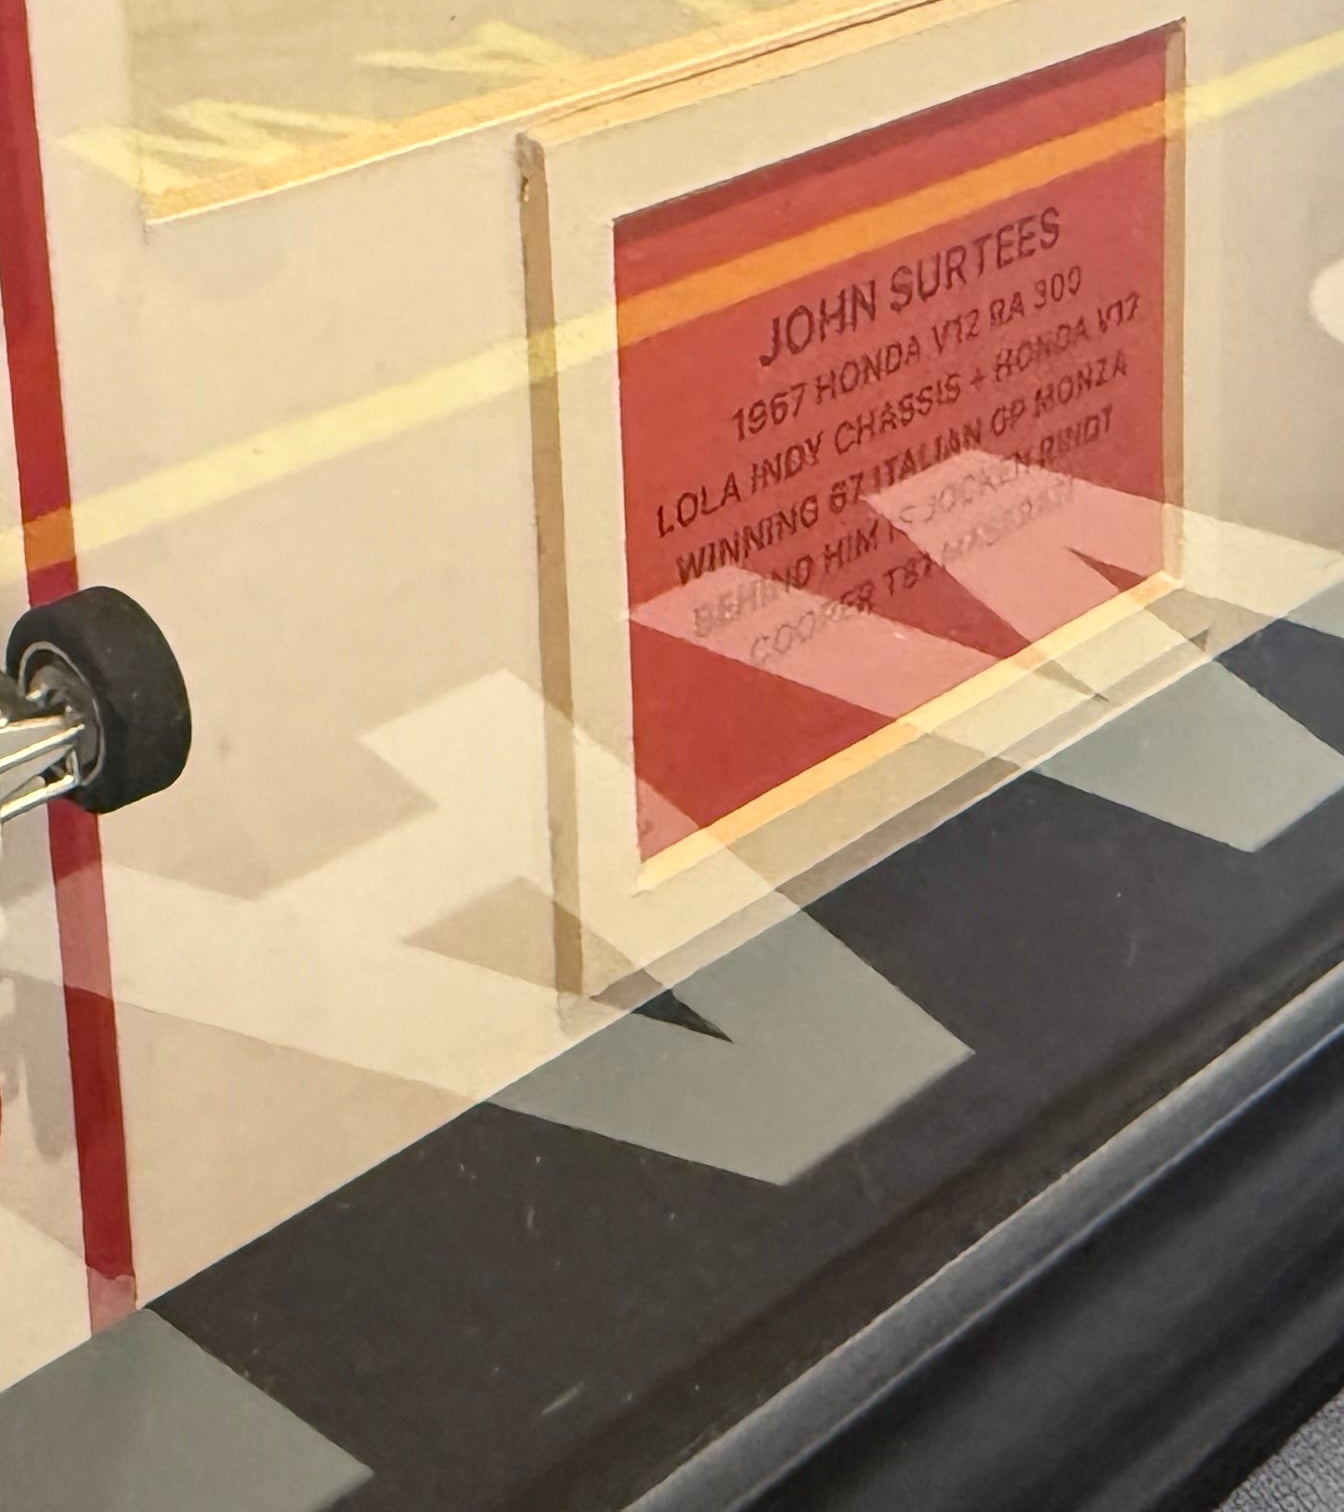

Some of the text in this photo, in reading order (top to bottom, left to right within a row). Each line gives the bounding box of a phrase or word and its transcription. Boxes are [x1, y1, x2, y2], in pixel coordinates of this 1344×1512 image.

[732, 264, 1084, 442] 1967 HONDA V12 RA 300
[759, 205, 1062, 368] JOHN SURTEES
[657, 471, 742, 539] LOLA
[750, 429, 827, 496] INDY
[833, 372, 962, 457] CHASSIS
[993, 314, 1089, 383] HONDA
[674, 347, 1130, 586] WINNING 67 ITALIAN GP MONZA
[693, 552, 815, 638] BEHIND
[823, 518, 881, 575] HIM
